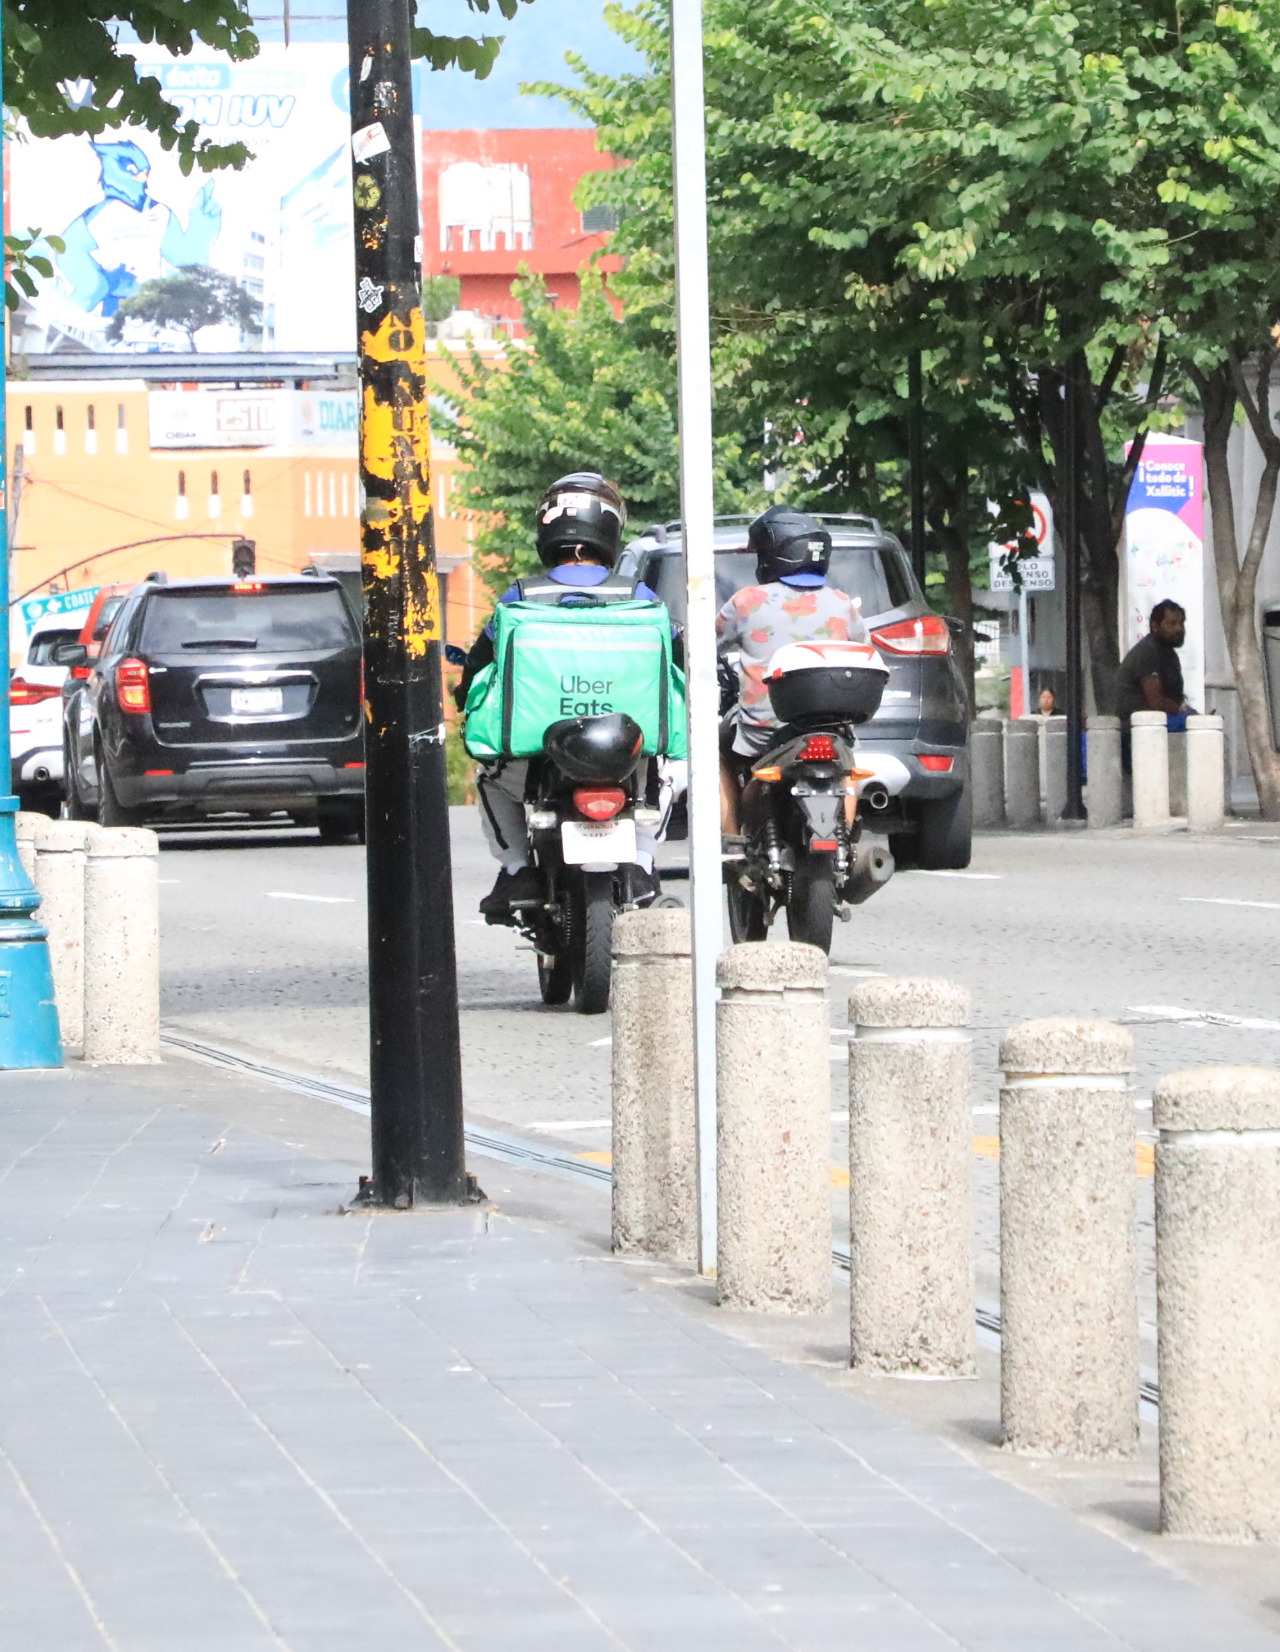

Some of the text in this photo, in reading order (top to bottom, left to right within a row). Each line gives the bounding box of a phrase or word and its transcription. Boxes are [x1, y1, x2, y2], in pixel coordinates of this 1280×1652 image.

[165, 66, 221, 88] éxito
[228, 95, 296, 128] IUV
[1145, 471, 1187, 483] todo de
[560, 675, 613, 694] Uber
[560, 697, 613, 717] Eats
